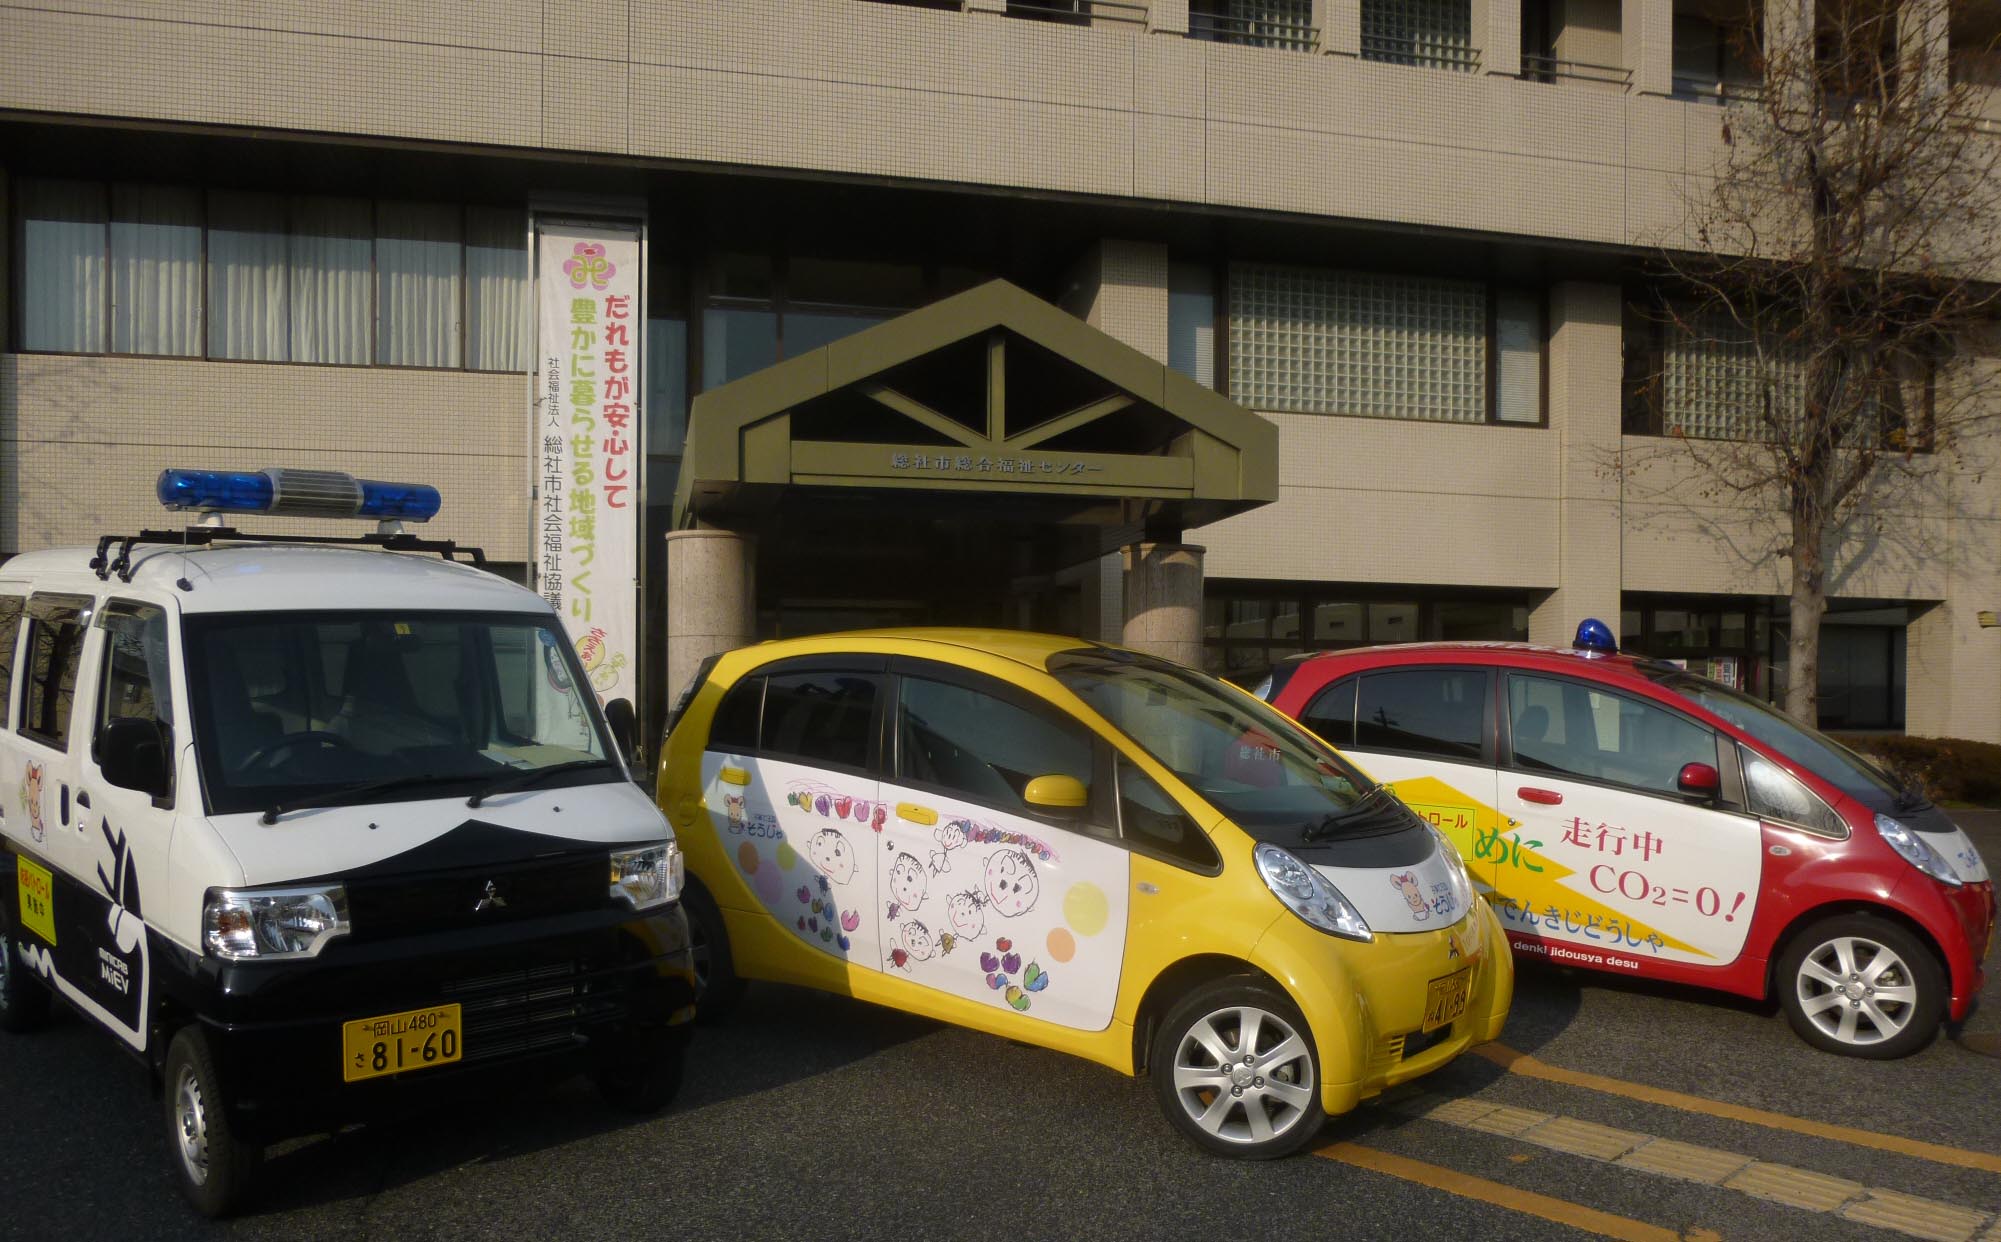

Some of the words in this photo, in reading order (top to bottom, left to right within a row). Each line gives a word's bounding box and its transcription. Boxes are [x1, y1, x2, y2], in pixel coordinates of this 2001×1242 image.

[547, 357, 560, 427] 社会福祉法人
[602, 295, 631, 508] だれもが安心して
[569, 298, 598, 622] 豊かに暮らせる地域づくり
[891, 452, 1103, 475] 総社市総合福祉センター
[1475, 827, 1544, 873] めに
[1560, 816, 1663, 862] 走行中
[1503, 898, 1664, 953] でんきじどうしゃ
[101, 962, 129, 995] MiEV
[1550, 946, 1603, 964] jidousya
[1606, 956, 1639, 969] desu
[372, 1029, 456, 1071] 81-60
